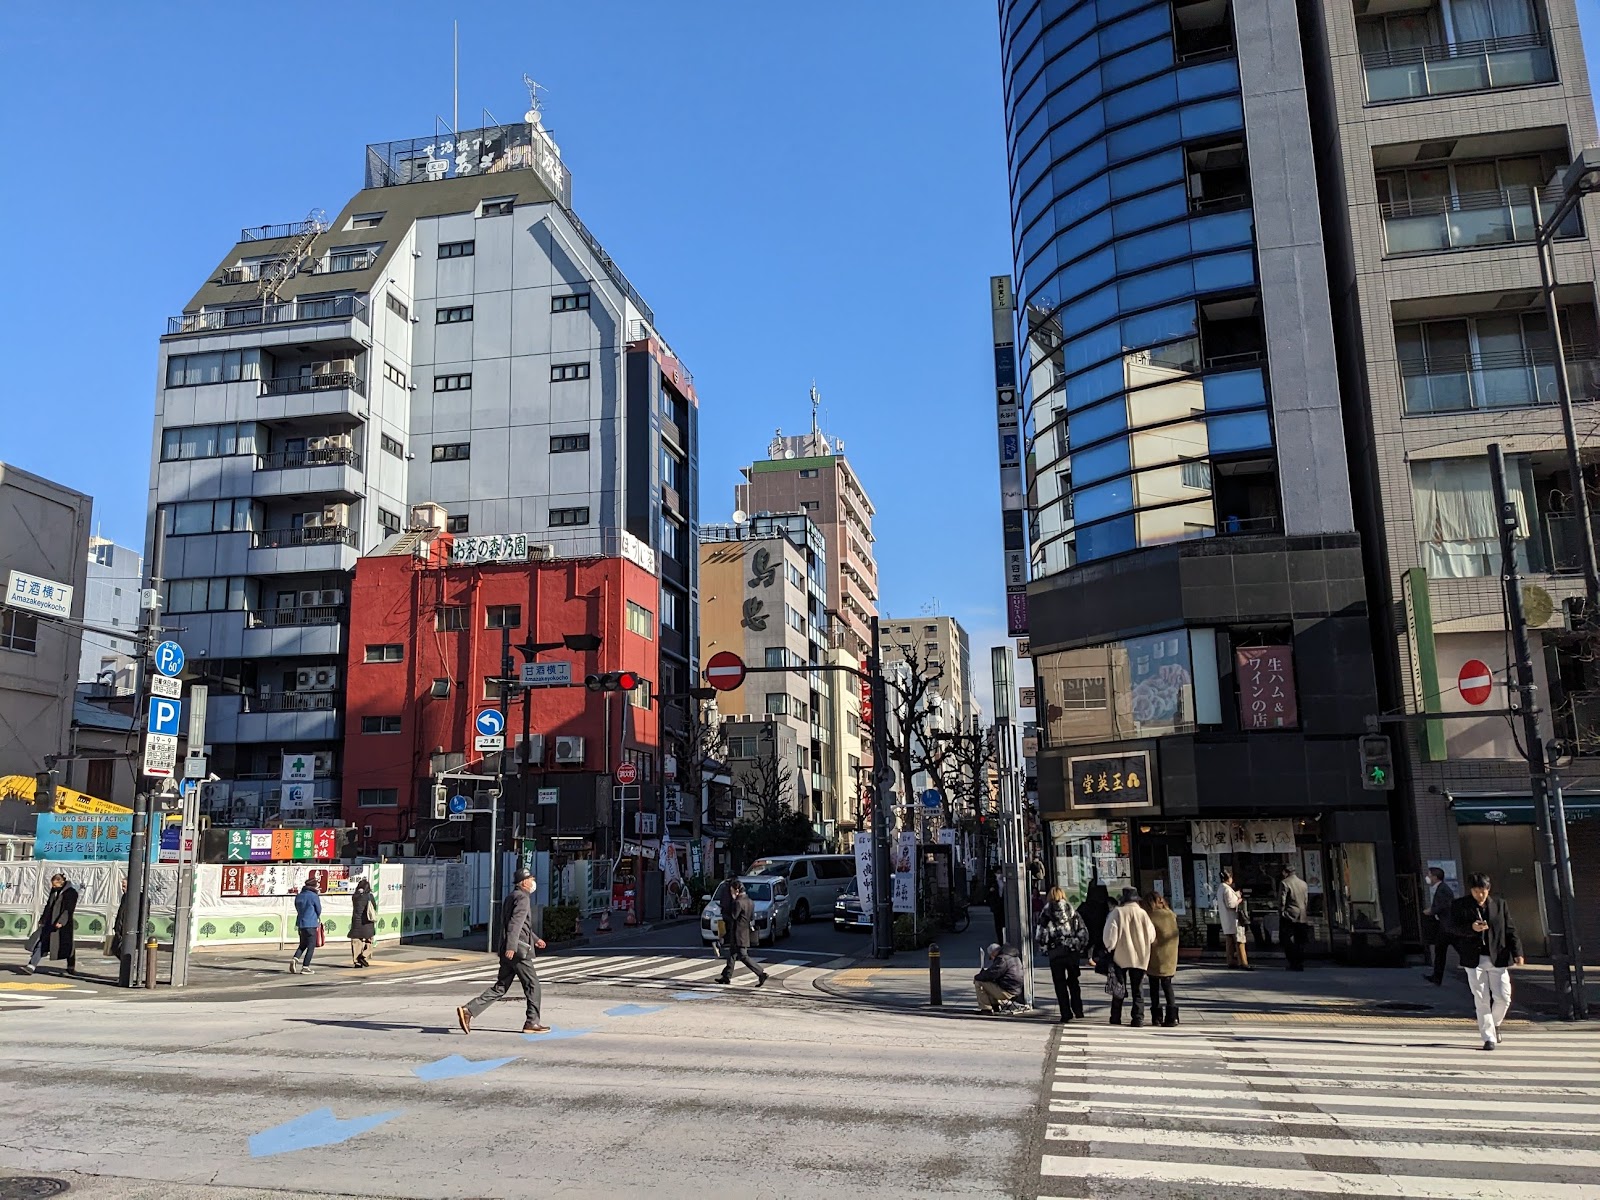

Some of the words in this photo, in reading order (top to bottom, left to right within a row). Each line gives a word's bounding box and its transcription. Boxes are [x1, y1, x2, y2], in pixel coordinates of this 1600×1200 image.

[454, 535, 526, 560] お茶の森乃園
[1011, 554, 1021, 583] 美容室
[11, 592, 66, 613] Amazakeyokocho
[15, 577, 67, 602] 甘酒横丁
[1013, 594, 1022, 629] GUSTAVO
[161, 648, 174, 670] P
[524, 664, 567, 676] 甘酒横丁
[1021, 690, 1035, 704] 亭
[1249, 658, 1268, 728] ワインの店
[156, 701, 175, 731] P
[228, 830, 243, 860] 魚久
[319, 830, 330, 858] 人形焼
